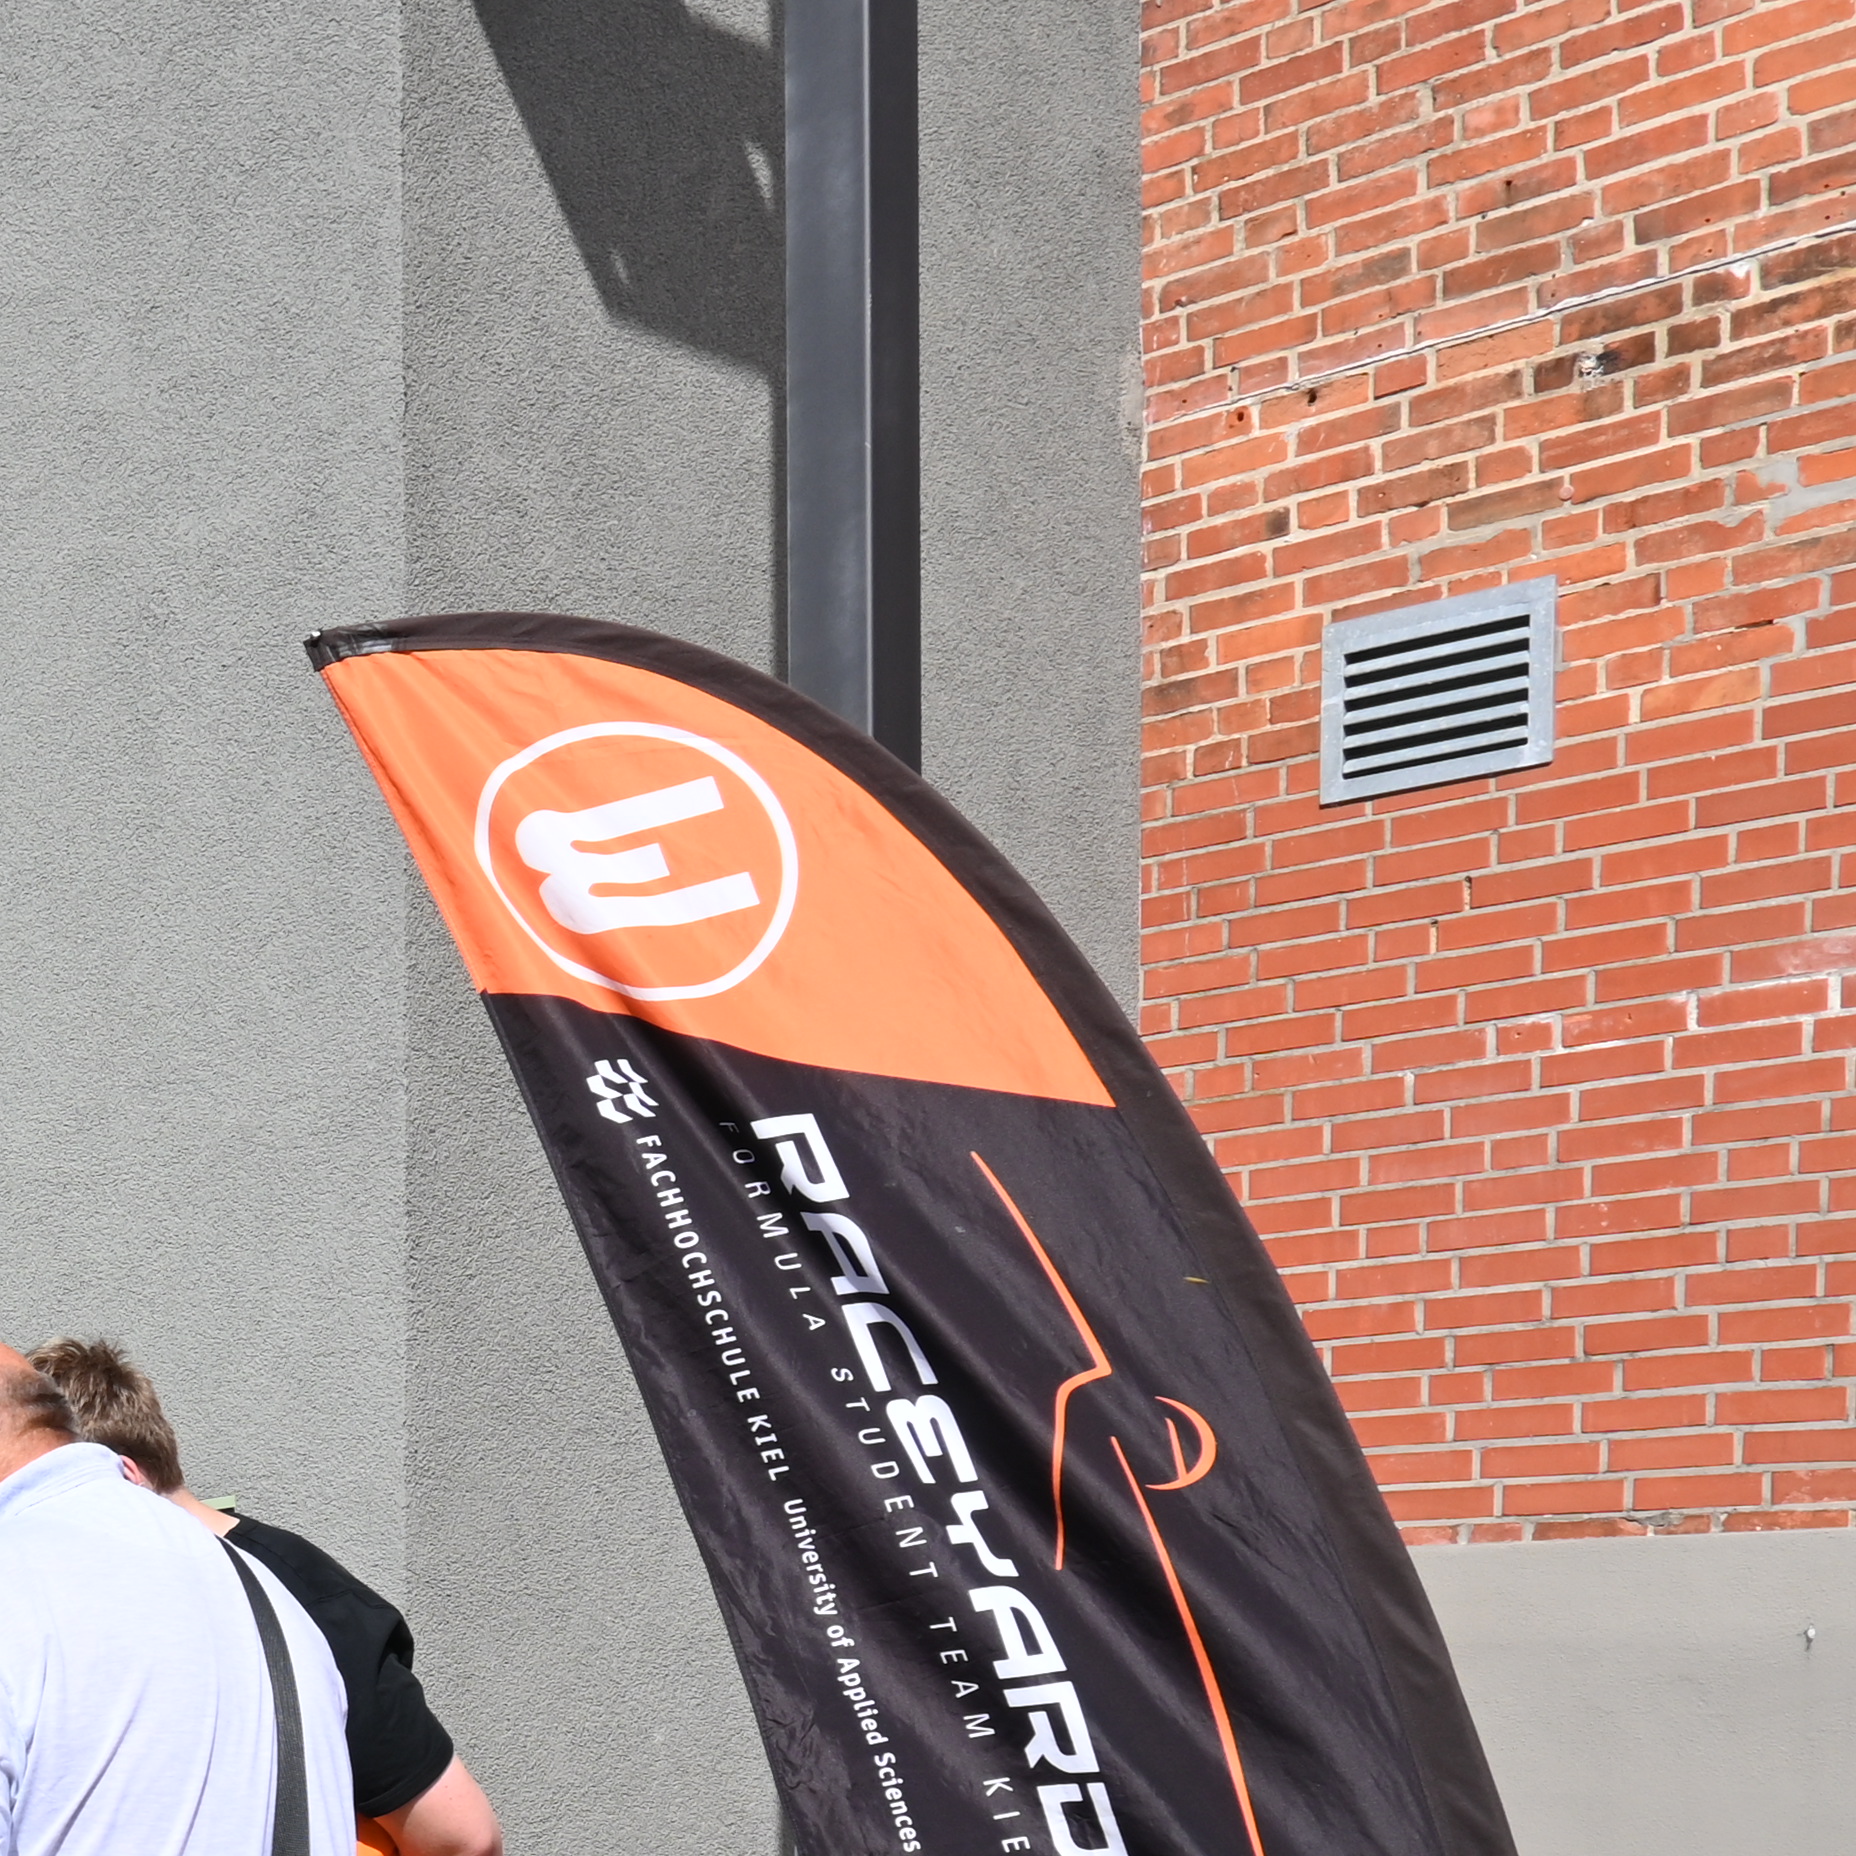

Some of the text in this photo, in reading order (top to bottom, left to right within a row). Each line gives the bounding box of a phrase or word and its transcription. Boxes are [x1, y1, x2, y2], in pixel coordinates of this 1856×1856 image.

[636, 1134, 924, 1855] FACHHOCHSCHULE KIEL University of Applied Sciences
[718, 1119, 828, 1334] FORMULA
[830, 1366, 941, 1583] STUDENT
[928, 1615, 997, 1741] TEAM
